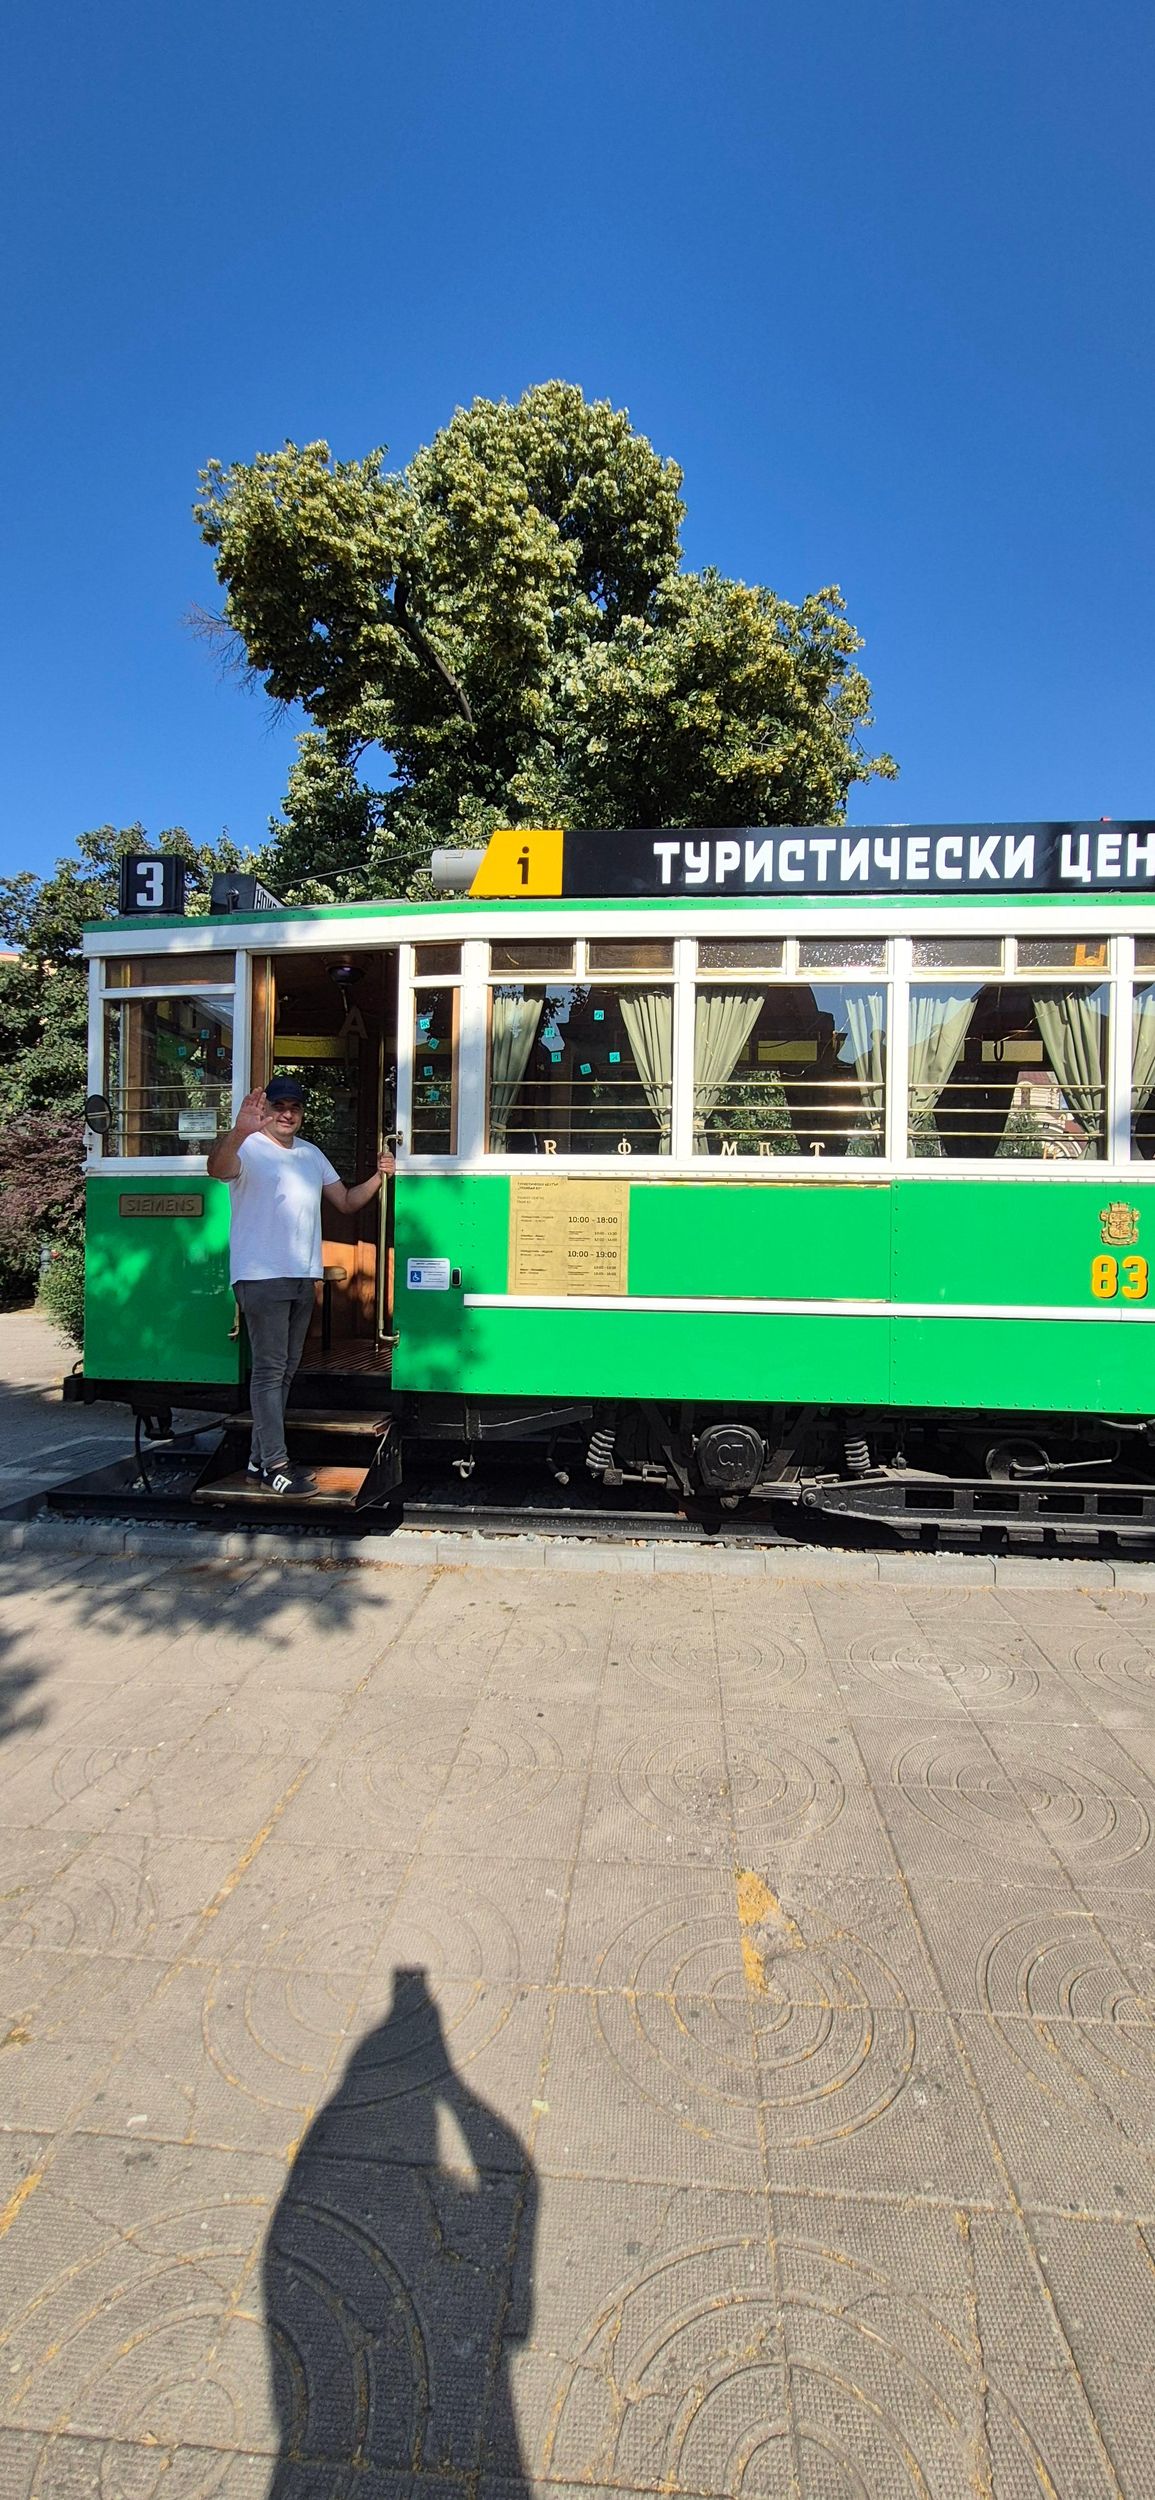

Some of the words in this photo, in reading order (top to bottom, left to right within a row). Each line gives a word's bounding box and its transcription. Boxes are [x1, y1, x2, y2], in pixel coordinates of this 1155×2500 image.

[653, 835, 1035, 885] ТУРИСТИЧЕСКИ
[1061, 832, 1155, 883] ЦЕН
[136, 861, 164, 907] 3
[127, 1199, 195, 1212] SIEMENS
[567, 1250, 589, 1258] 10:00
[1091, 1255, 1148, 1299] 83
[272, 1474, 293, 1494] GT
